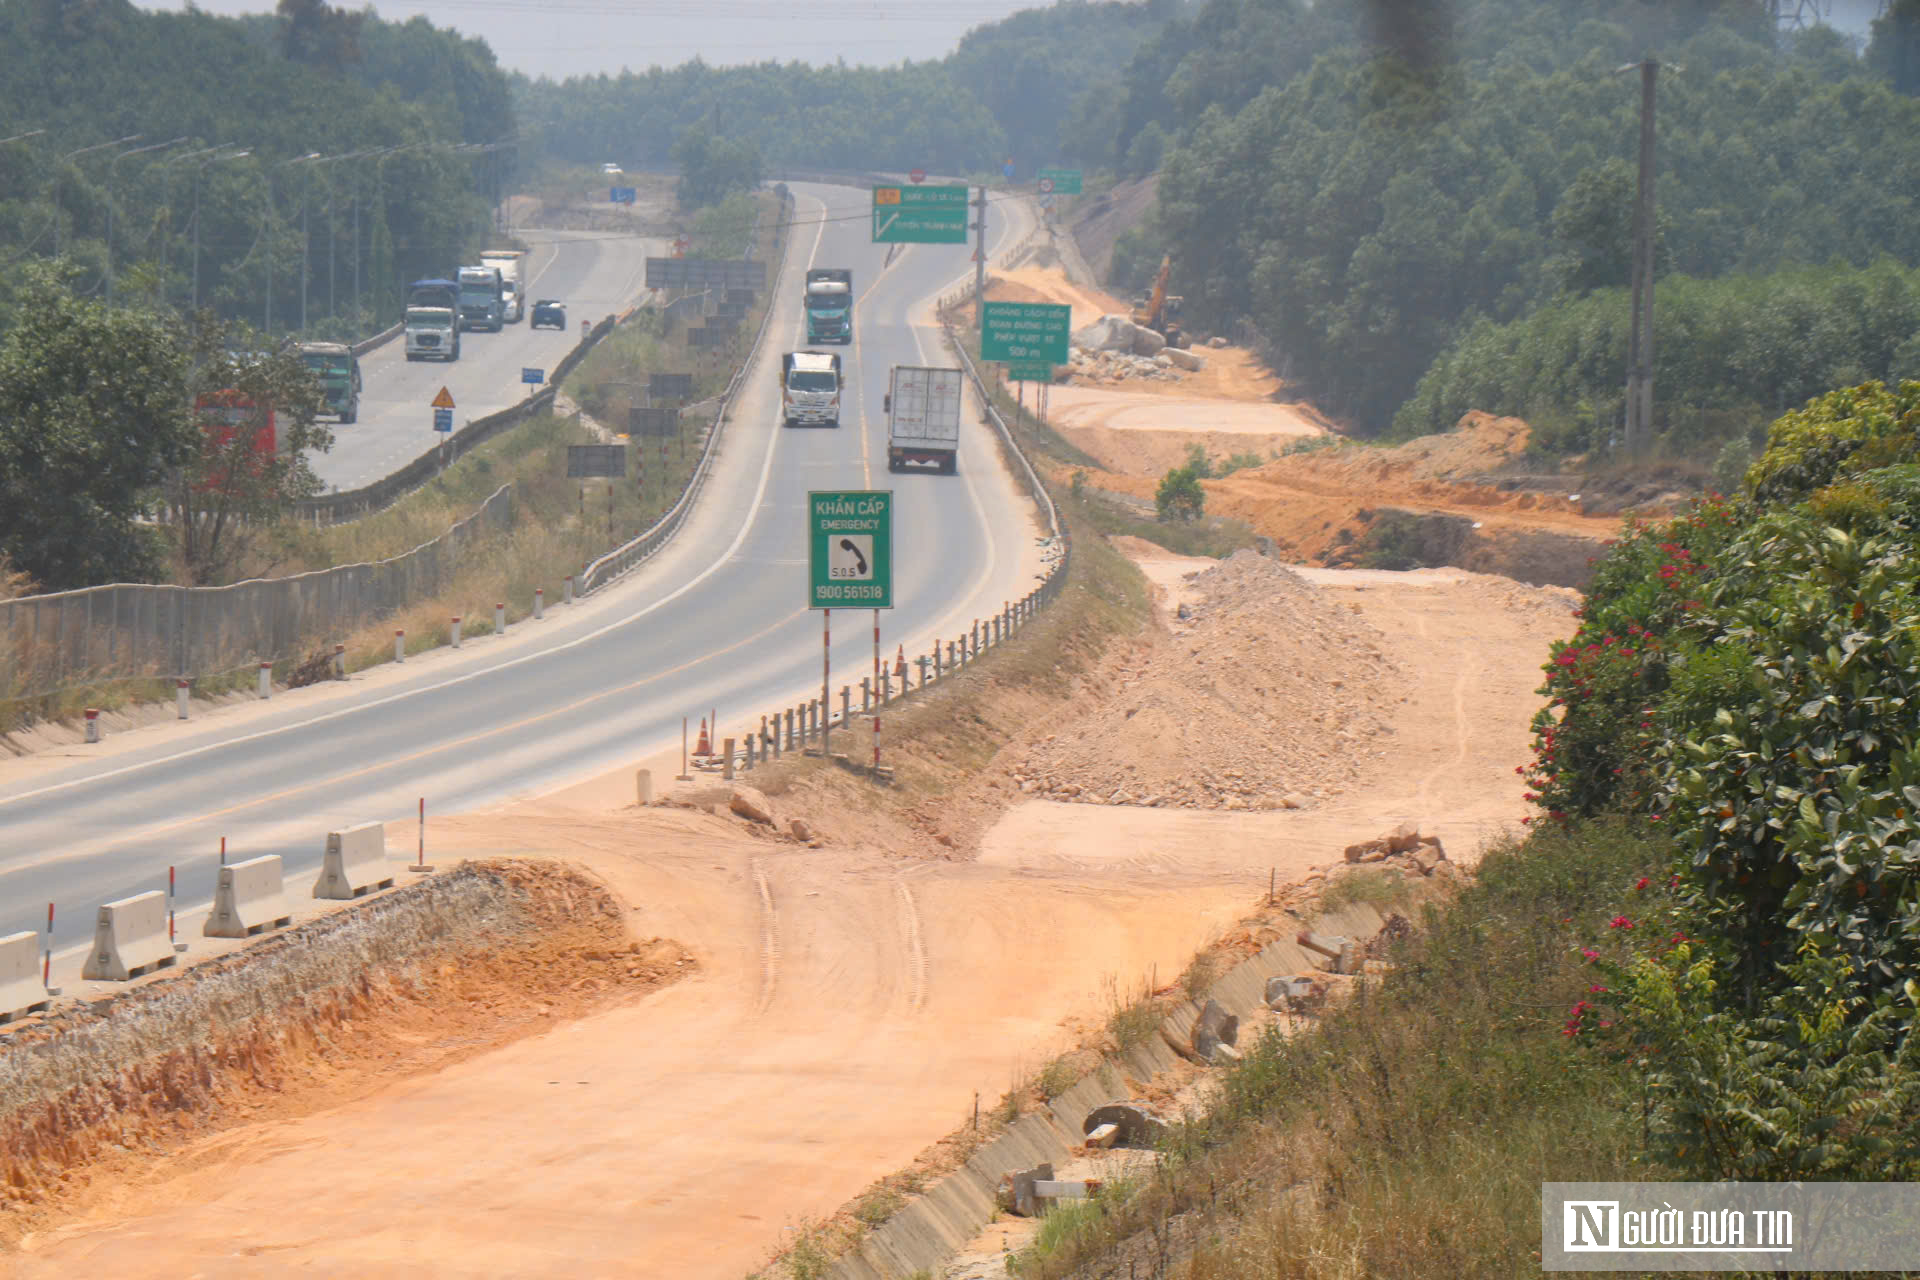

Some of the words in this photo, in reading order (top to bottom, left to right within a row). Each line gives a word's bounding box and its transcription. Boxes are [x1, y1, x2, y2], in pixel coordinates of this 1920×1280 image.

[1009, 345, 1027, 358] 500
[816, 495, 855, 515] KHẨN
[858, 495, 885, 515] CẤP
[821, 519, 880, 530] EMERGENCY
[816, 585, 841, 599] 1900
[843, 585, 883, 599] 561518
